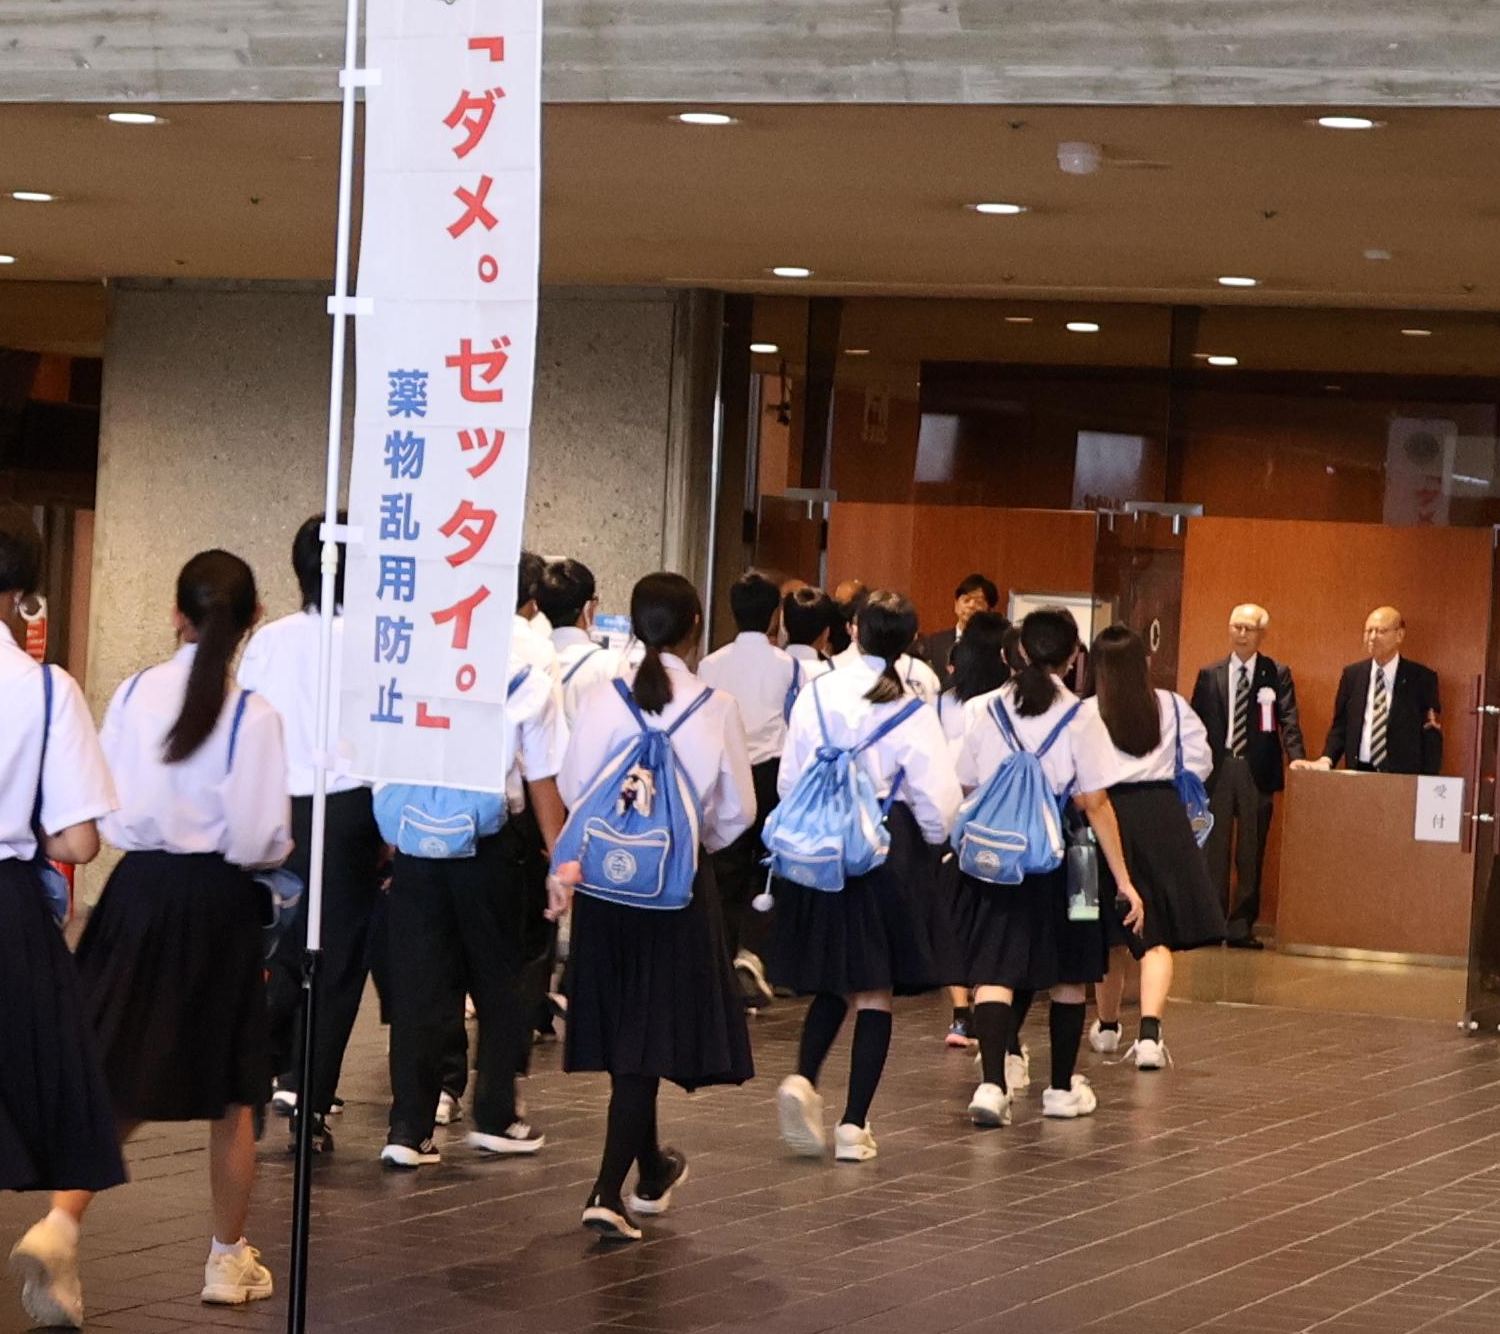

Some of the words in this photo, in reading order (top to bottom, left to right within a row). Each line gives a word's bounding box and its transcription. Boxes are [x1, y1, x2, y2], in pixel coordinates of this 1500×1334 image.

[370, 369, 429, 725] 薬物乱用防止
